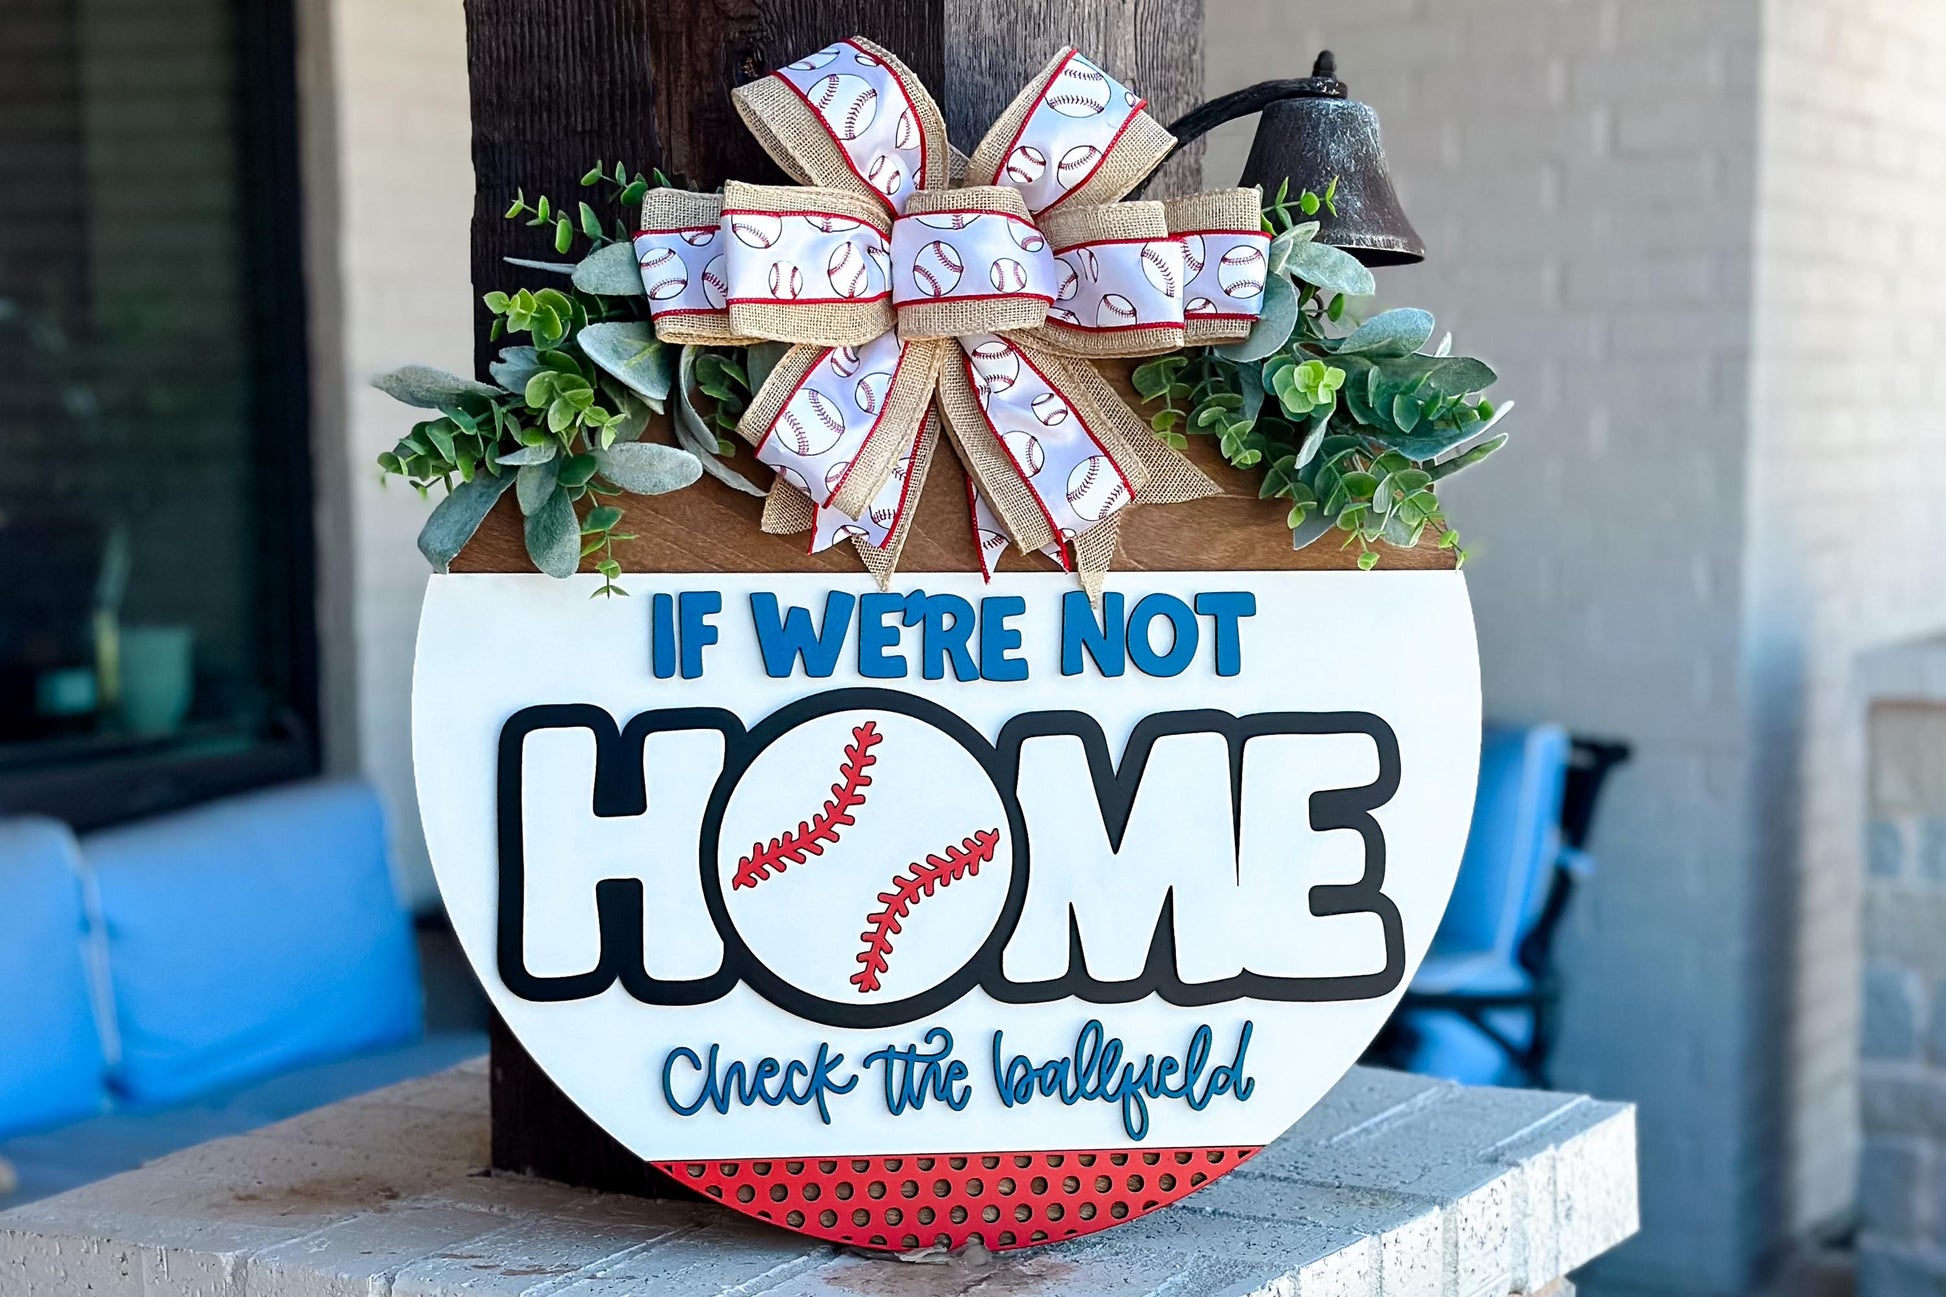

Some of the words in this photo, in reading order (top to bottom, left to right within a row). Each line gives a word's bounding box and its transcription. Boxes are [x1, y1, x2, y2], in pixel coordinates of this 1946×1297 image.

[652, 590, 722, 680] IF
[749, 588, 1029, 682] WE'RE
[1060, 590, 1257, 679] NOT
[498, 686, 1405, 1029] HOME
[661, 1041, 860, 1125] Check
[862, 1026, 973, 1115] the
[991, 1018, 1256, 1142] ballfield
